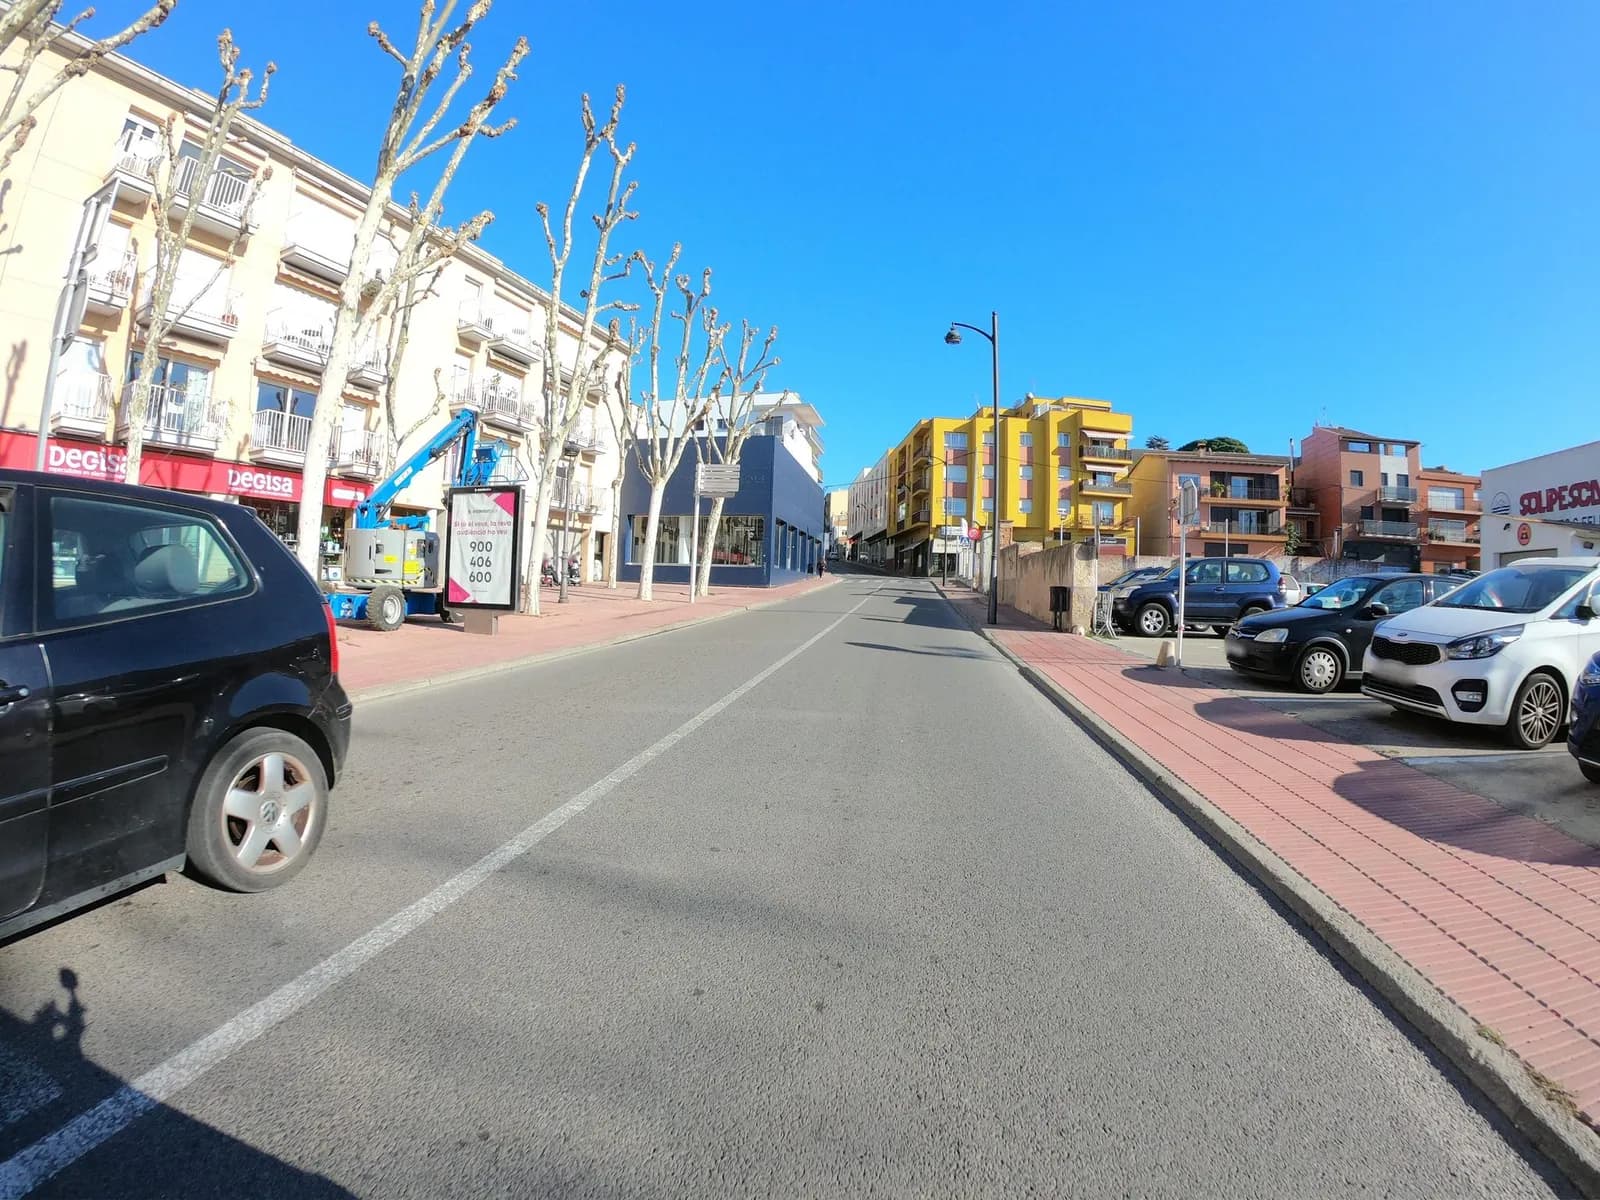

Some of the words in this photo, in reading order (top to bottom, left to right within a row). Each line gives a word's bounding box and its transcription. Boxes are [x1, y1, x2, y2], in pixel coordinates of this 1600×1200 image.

[469, 541, 493, 552] 900
[469, 556, 492, 567] 406
[469, 571, 492, 582] 600
